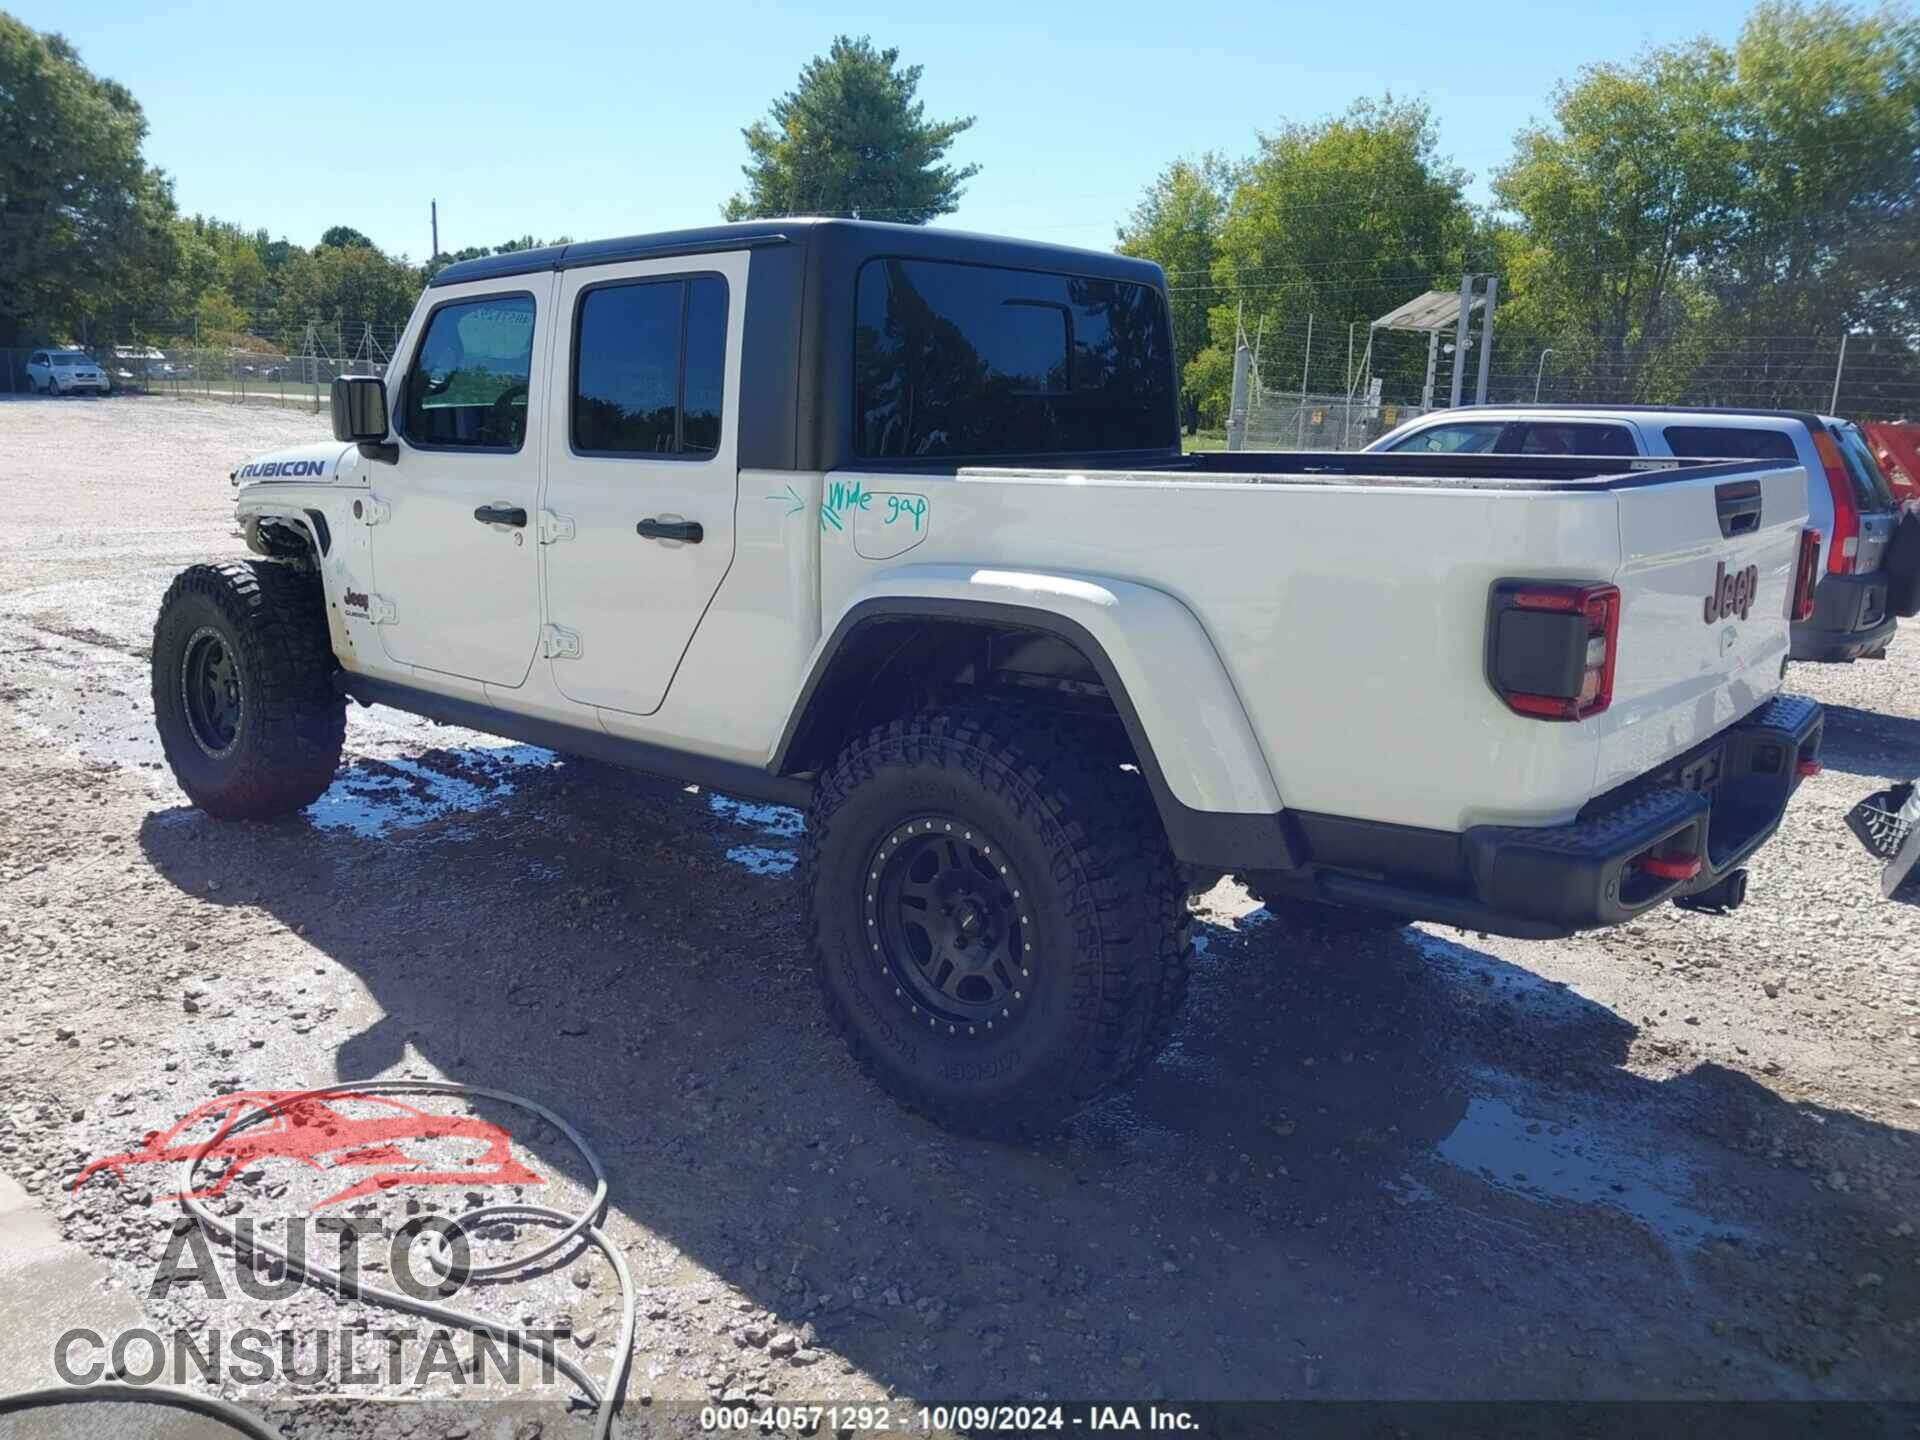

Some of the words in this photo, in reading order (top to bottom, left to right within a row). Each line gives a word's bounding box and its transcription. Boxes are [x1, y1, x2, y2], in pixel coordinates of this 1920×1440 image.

[240, 460, 326, 478] RUBICON
[829, 480, 872, 511] Wide
[885, 495, 926, 531] gap
[1703, 560, 1758, 625] Jeep
